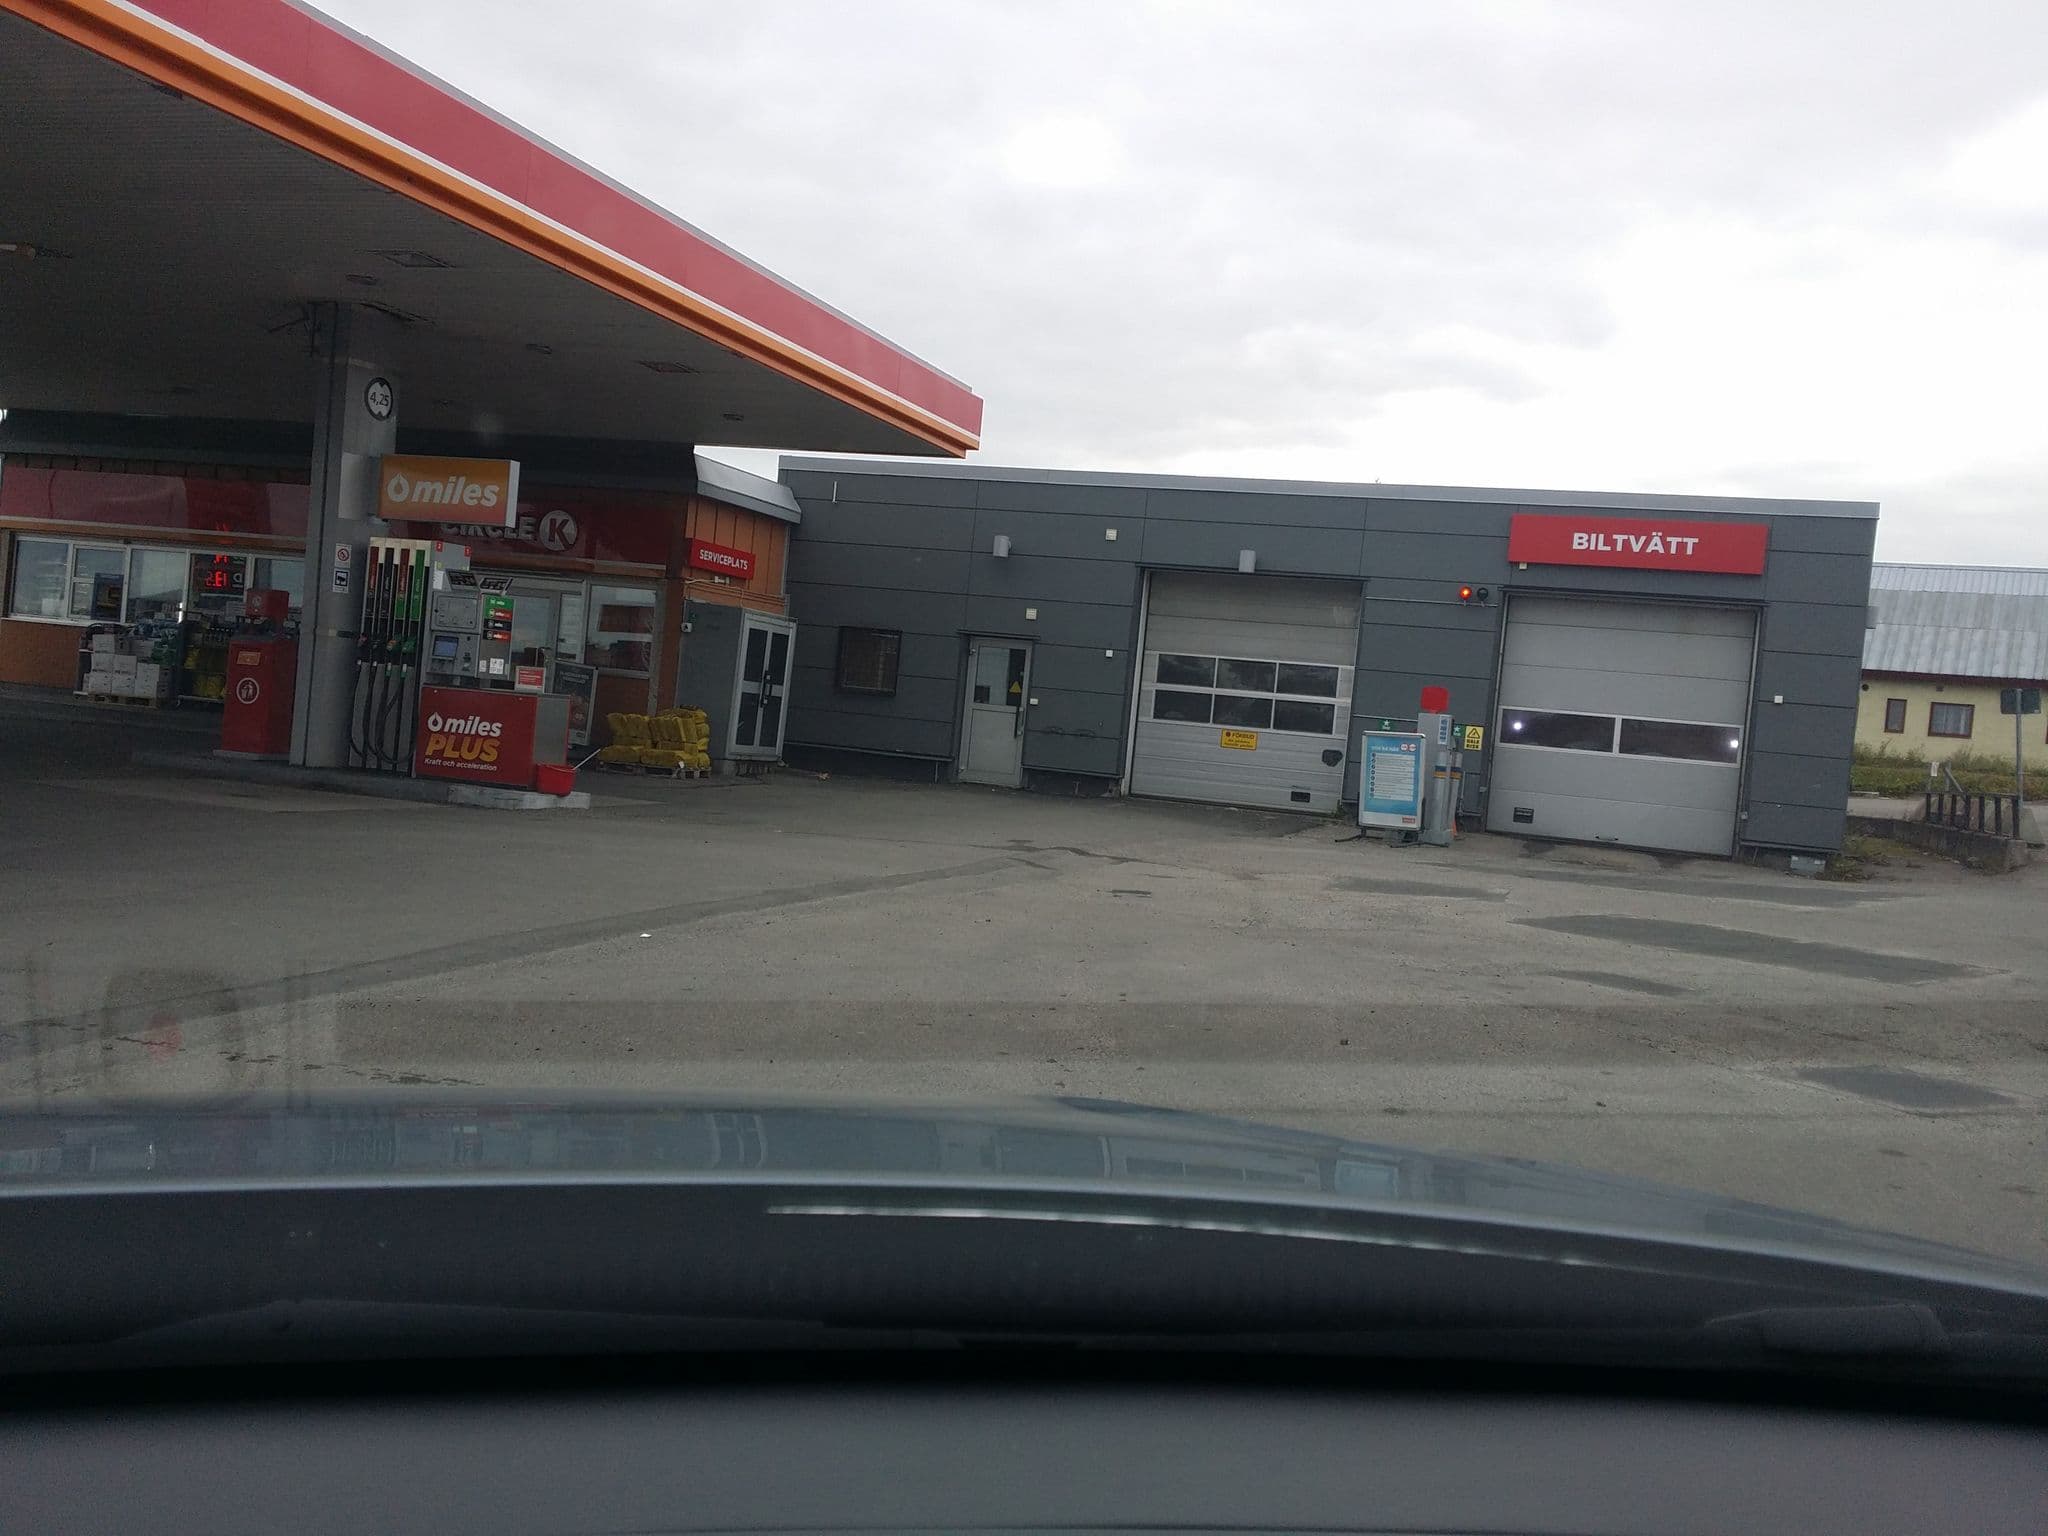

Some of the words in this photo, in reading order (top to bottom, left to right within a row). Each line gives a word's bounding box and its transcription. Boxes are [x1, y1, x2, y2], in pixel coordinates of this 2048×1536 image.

[369, 391, 389, 407] 4,25
[411, 476, 500, 507] miles
[549, 517, 575, 550] K
[1572, 531, 1700, 555] BILTVÄTT
[699, 549, 749, 570] SERVICEPLATS
[443, 715, 503, 737] miles
[425, 734, 501, 762] PLUS
[424, 758, 442, 766] Kraft
[442, 759, 455, 768] och
[456, 761, 497, 772] acceleration
